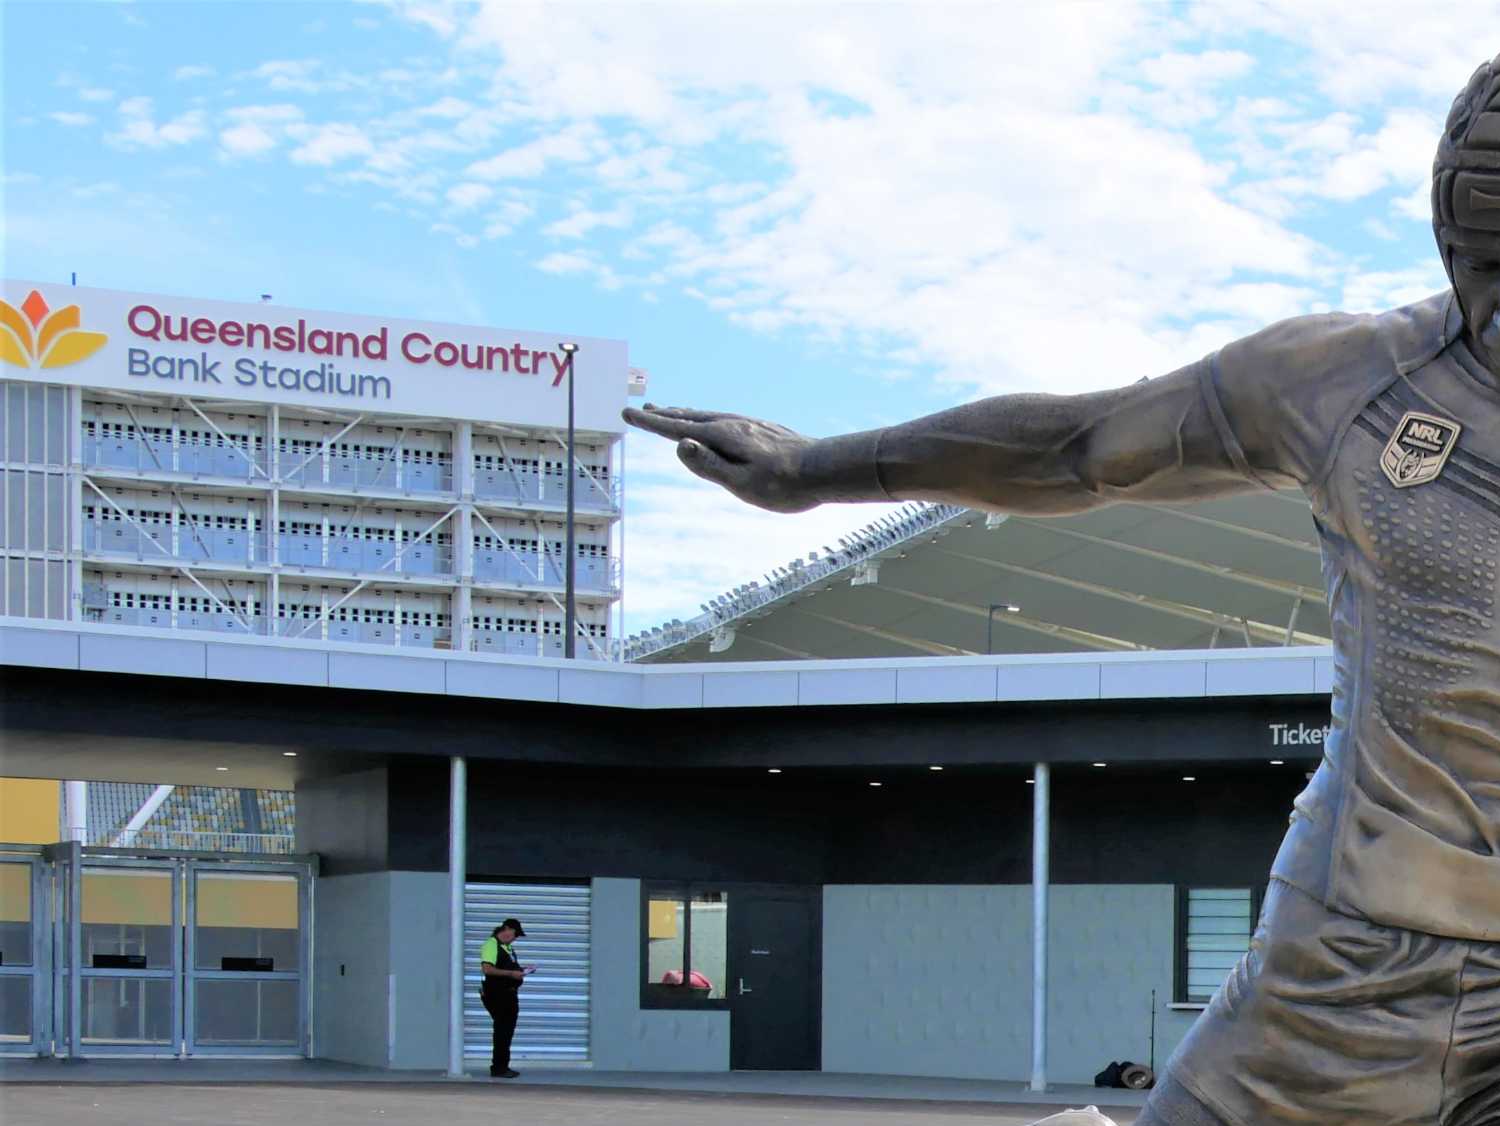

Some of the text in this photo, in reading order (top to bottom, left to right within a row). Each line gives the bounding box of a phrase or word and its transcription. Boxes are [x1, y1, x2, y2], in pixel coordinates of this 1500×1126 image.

[127, 304, 571, 387] Queensland Country
[127, 347, 391, 399] Bank Stadium
[1408, 421, 1444, 445] NRL
